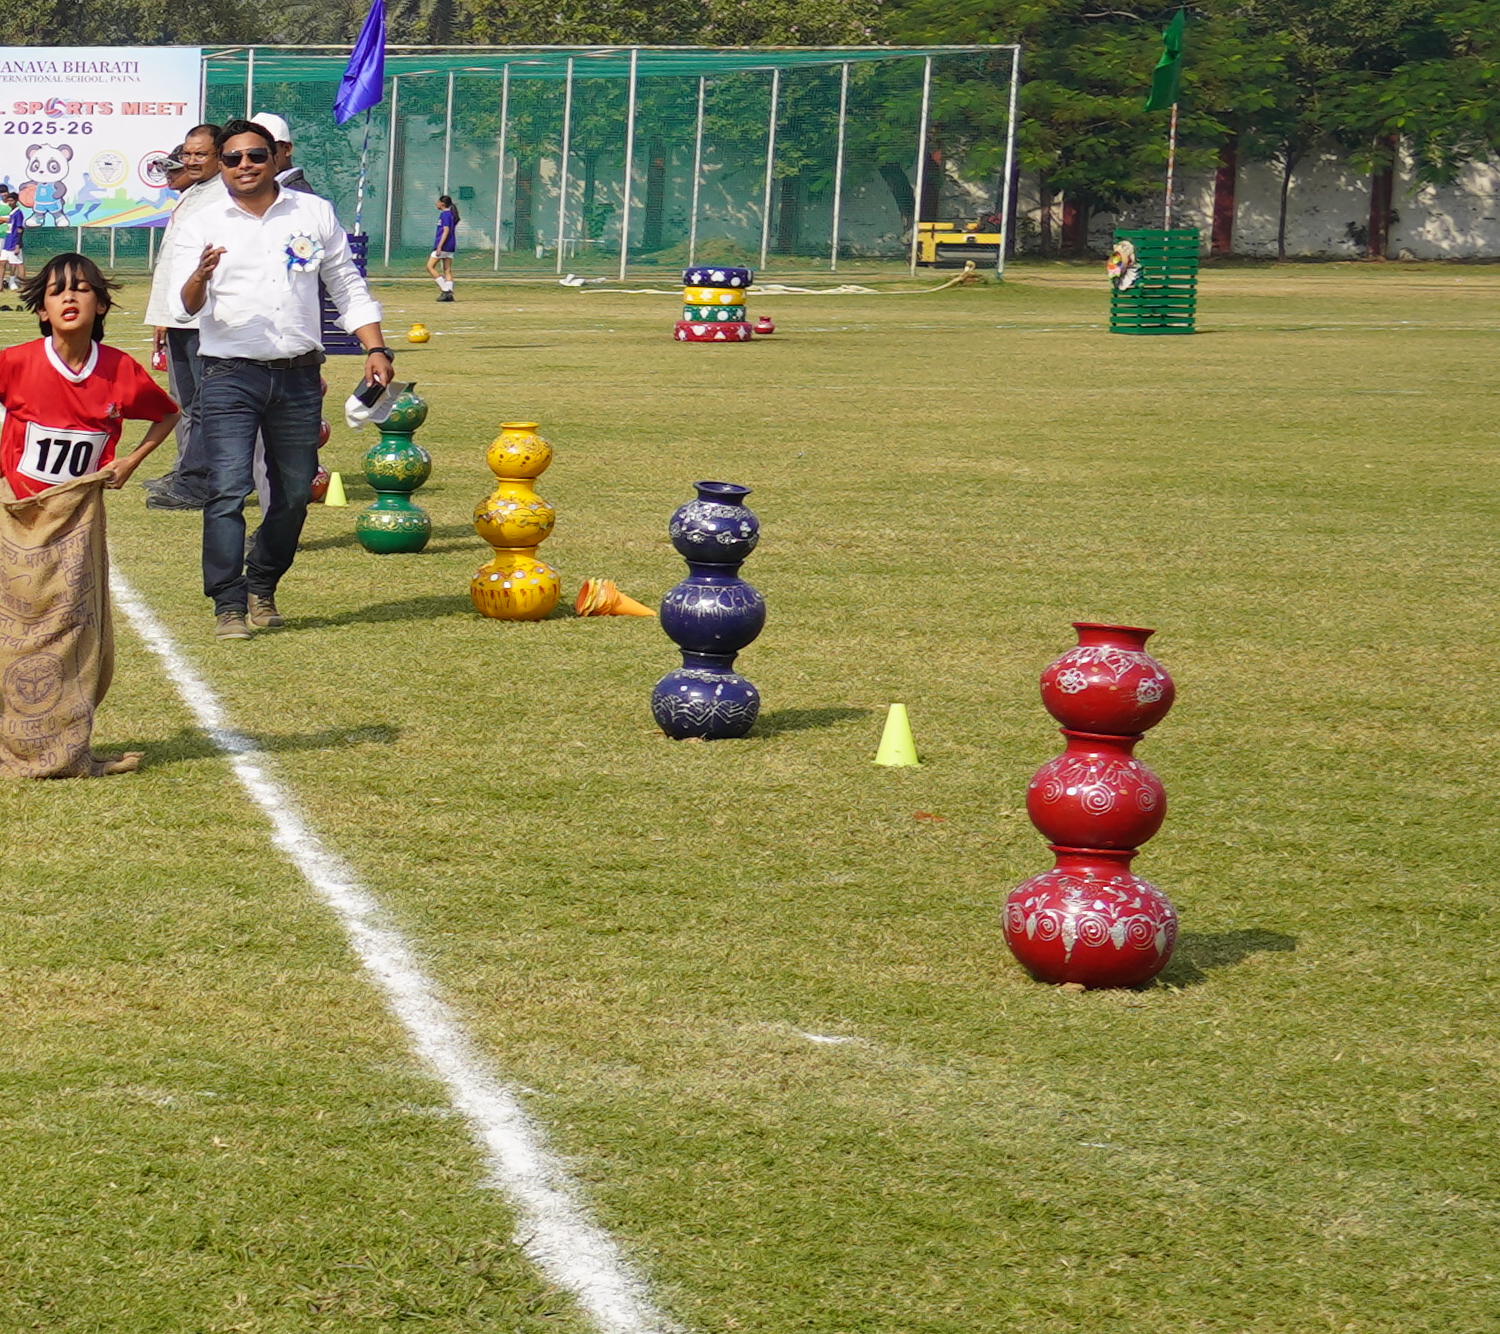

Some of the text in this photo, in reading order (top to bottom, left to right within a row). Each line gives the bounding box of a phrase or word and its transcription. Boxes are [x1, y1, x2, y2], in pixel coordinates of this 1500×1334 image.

[63, 60, 140, 74] BHARATI
[13, 99, 114, 117] SPORTS
[121, 101, 188, 116] MEET
[4, 120, 93, 135] 2025-26
[36, 437, 94, 478] 170
